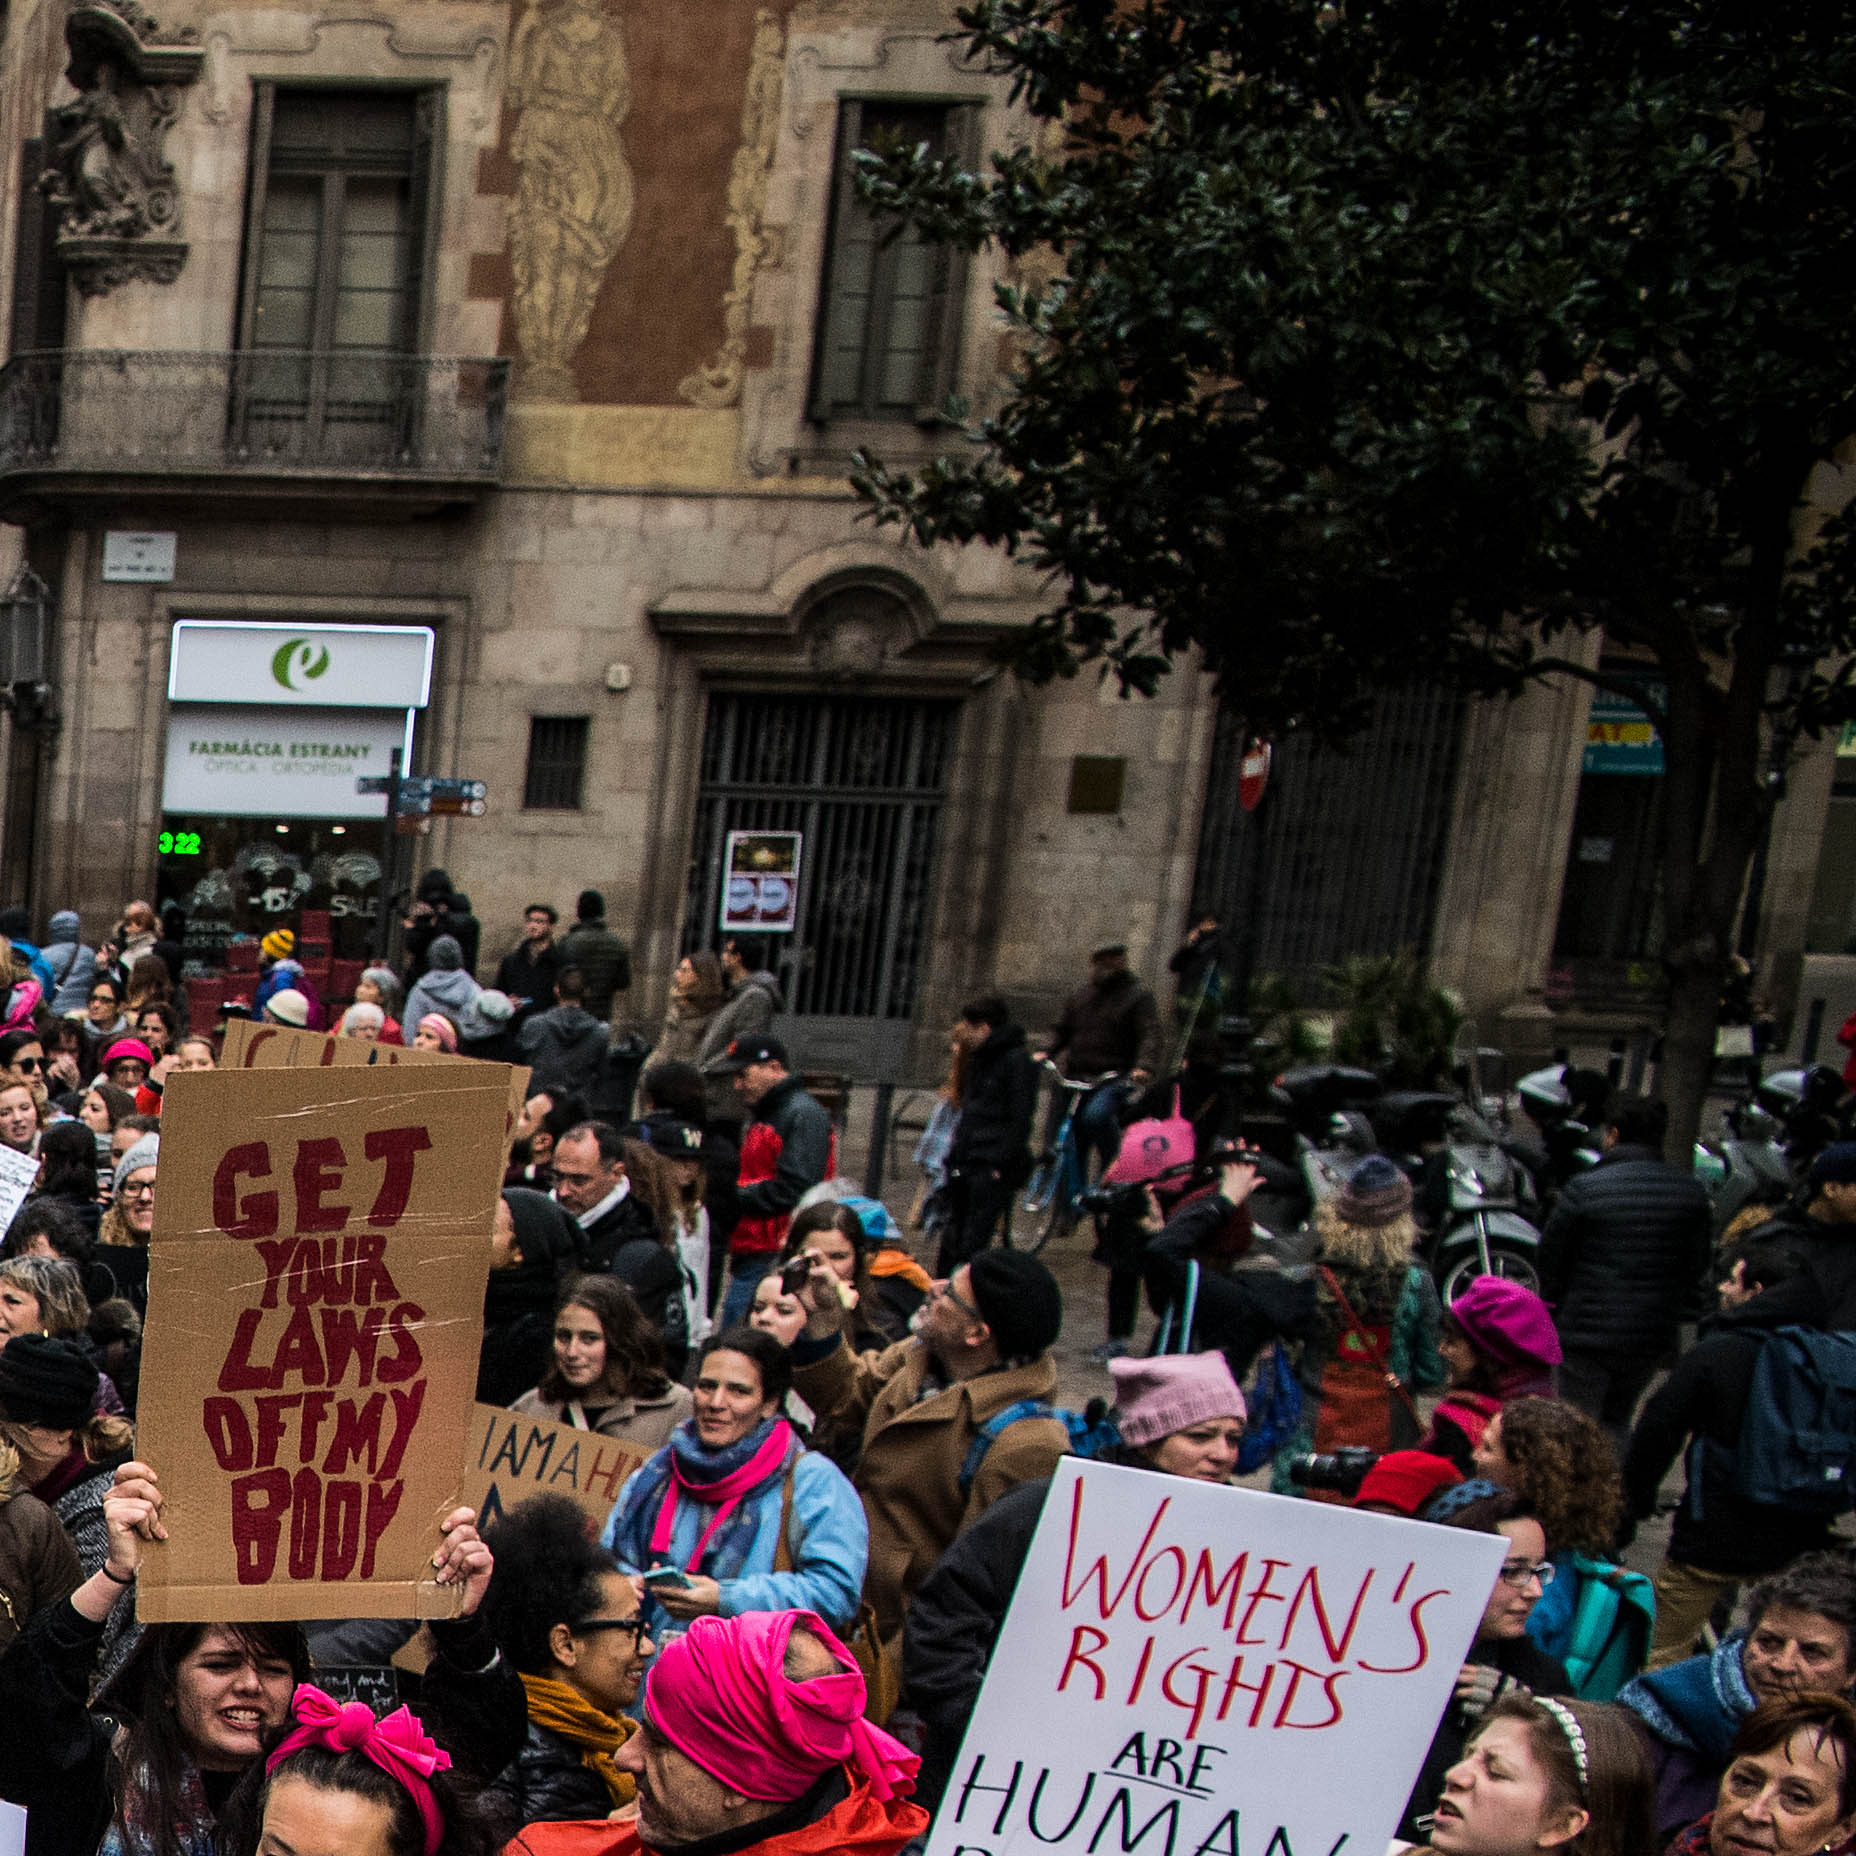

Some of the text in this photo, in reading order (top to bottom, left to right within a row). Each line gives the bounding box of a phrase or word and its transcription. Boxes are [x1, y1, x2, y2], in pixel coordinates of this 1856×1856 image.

[289, 742, 373, 759] ESTRANY
[212, 1126, 434, 1241] GET
[682, 1127, 703, 1149] W
[253, 1233, 403, 1310] YOUR
[217, 1302, 427, 1393] LAWS
[203, 1378, 429, 1482] OFF MY
[479, 1415, 580, 1490] I AM A
[231, 1466, 406, 1586] BODY
[1059, 1475, 1452, 1674] WOMEN'S
[1056, 1624, 1353, 1741] RIGHTS
[1108, 1730, 1229, 1795] ARE
